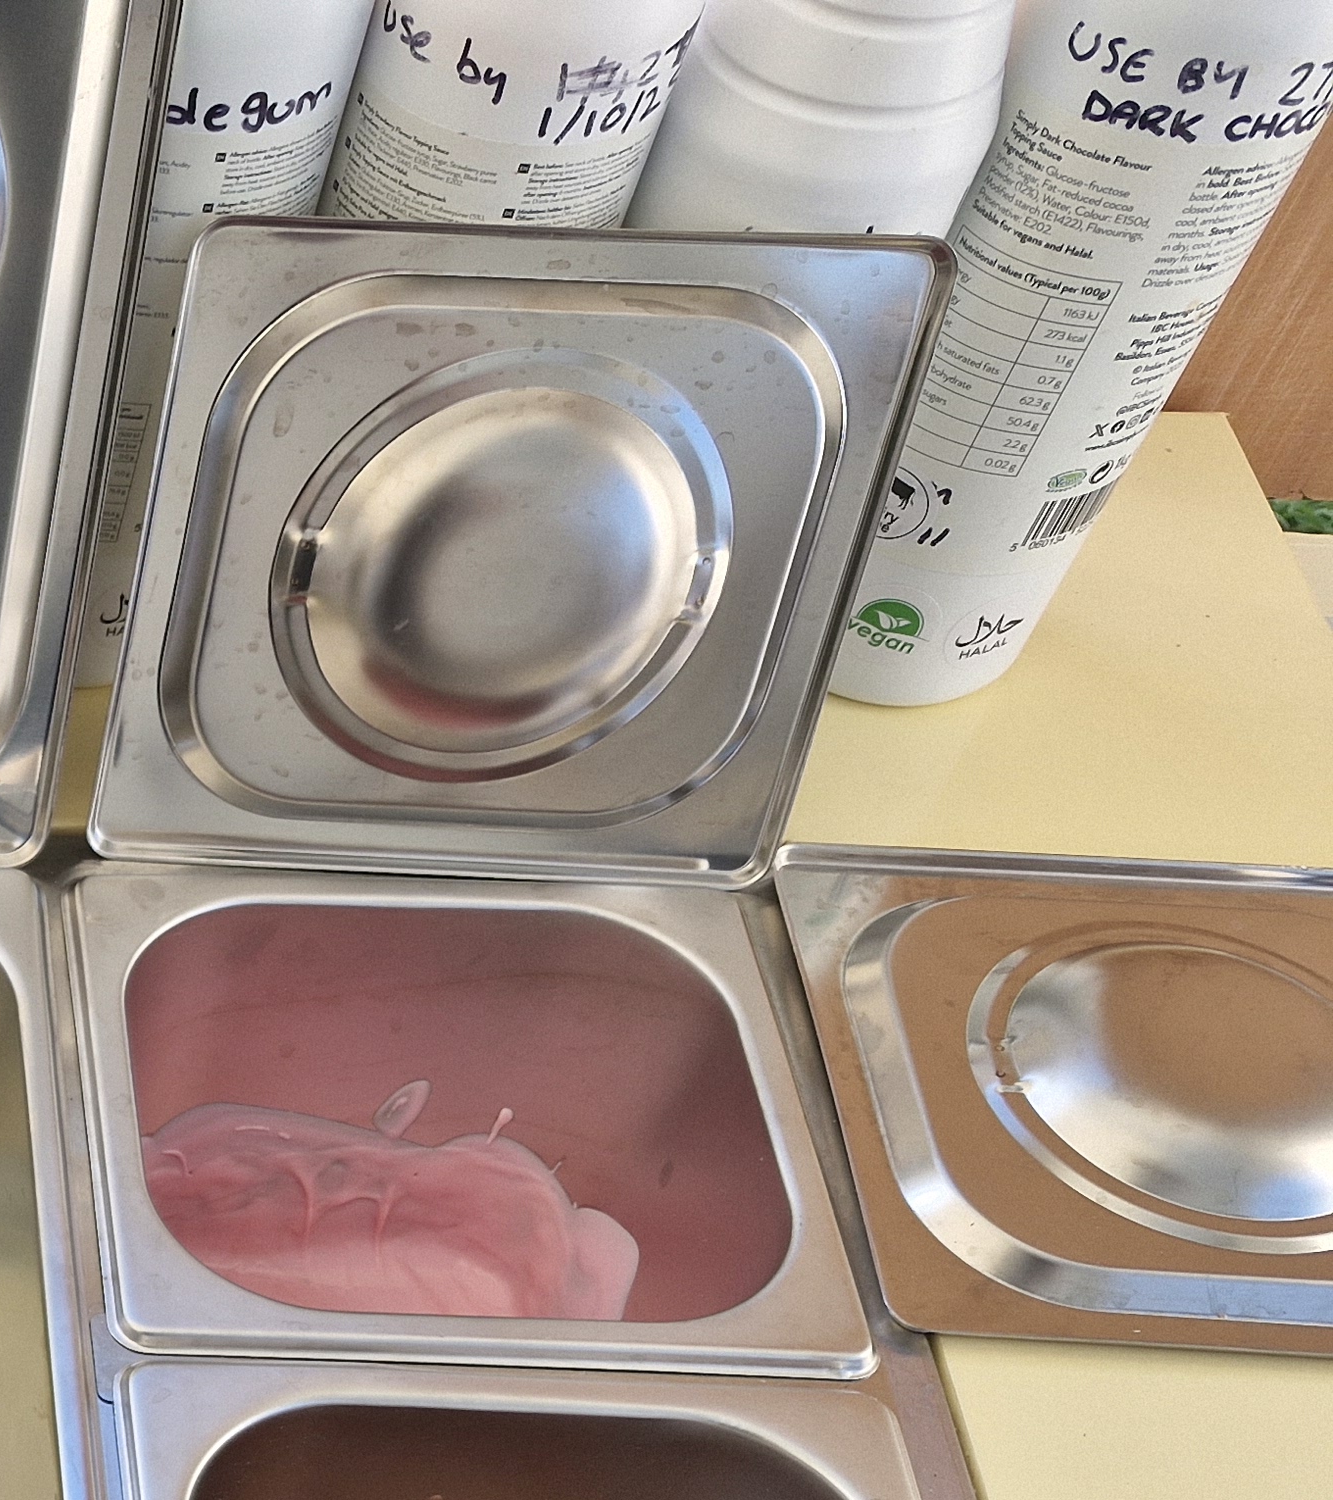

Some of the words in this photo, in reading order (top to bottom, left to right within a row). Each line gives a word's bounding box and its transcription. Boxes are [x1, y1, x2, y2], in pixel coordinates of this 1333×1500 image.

[1068, 21, 1155, 83] USE
[1082, 89, 1205, 144] DARK
[1010, 121, 1036, 150] Topping
[1039, 142, 1063, 162] Sauce
[1016, 110, 1038, 135] Simply
[1040, 127, 1062, 146] Dark
[1063, 139, 1111, 164] Chocolate
[1113, 156, 1152, 172] Flavour
[1002, 137, 1044, 172] Ingredients:
[1046, 165, 1131, 198] Glucose-fructose
[1016, 165, 1039, 187] Sugar,
[1041, 180, 1102, 207] Fat-reduced
[1103, 200, 1134, 212] cocoa
[972, 199, 998, 228] Suitable
[1013, 228, 1042, 246] vegans
[1043, 241, 1064, 253] and
[1064, 246, 1094, 260] Halal.
[1014, 196, 1040, 216] starch
[1042, 209, 1083, 232] (E1422),
[1086, 223, 1145, 242] Flavourings,
[1042, 194, 1072, 214] Water,
[1075, 206, 1111, 223] Colour:
[1114, 213, 1151, 229] E150d,
[959, 236, 997, 268] Nutritional
[997, 261, 1023, 281] values
[1023, 273, 1061, 294] (Typical
[1061, 285, 1079, 298] per
[1081, 286, 1111, 301] 100g)
[1062, 308, 1086, 320] 1163
[1044, 329, 1065, 341] 273
[1066, 332, 1087, 343] kcal
[942, 345, 983, 369] saturated
[983, 361, 1000, 375] fats
[1037, 375, 1054, 386] 0.7
[984, 458, 1009, 469] 0.02
[958, 637, 1008, 661] HALAL
